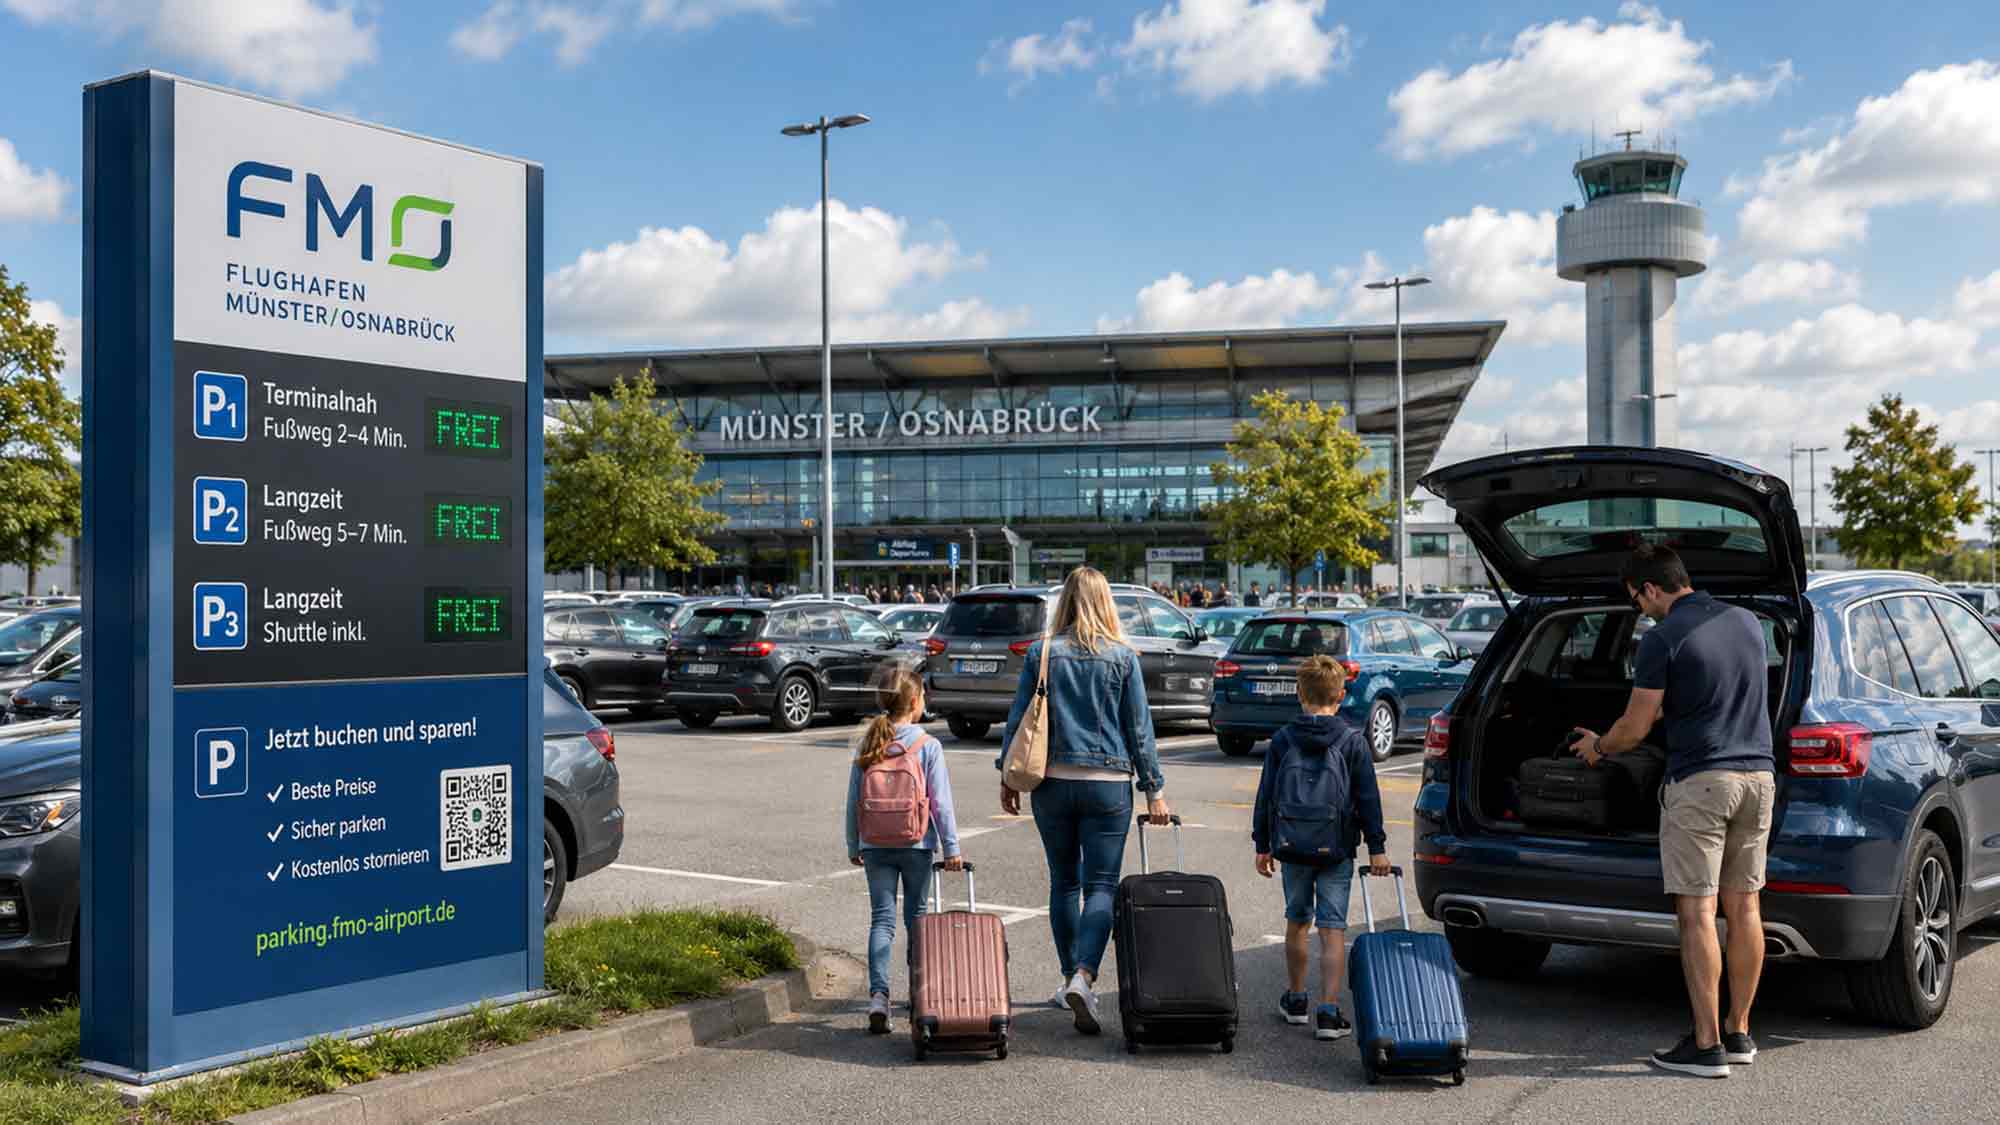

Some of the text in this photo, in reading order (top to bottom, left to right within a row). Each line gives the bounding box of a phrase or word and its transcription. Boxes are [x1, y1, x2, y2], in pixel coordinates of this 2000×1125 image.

[226, 160, 455, 272] FMO
[226, 263, 366, 302] FLUGHAFEN
[226, 292, 455, 342] MÜNSTER/OSNABRÜCK
[203, 383, 237, 429] P1
[263, 381, 377, 415] Terminalnah
[264, 416, 332, 448] Fußweg
[373, 426, 407, 449] Min.
[437, 410, 500, 449] FREI
[720, 409, 866, 440] MÜNSTER
[900, 401, 1102, 437] OSNABRÜCK
[202, 489, 240, 533] P2
[263, 484, 343, 514] Langzeit
[264, 519, 332, 548] Fußweg
[373, 523, 407, 544] Min.
[437, 503, 501, 540] FREI
[202, 595, 239, 637] P3
[263, 587, 344, 615] Langzeit
[437, 599, 501, 633] FREI
[263, 620, 366, 643] Shuttle inkl.
[264, 716, 477, 751] Jetzt buchen und sparen!
[209, 739, 236, 786] P
[291, 777, 377, 801] Beste Preise
[291, 815, 386, 840] Sicher parken
[291, 848, 430, 879] Kostenlos stornieren
[256, 900, 456, 957] parking.fmo-airport.de
